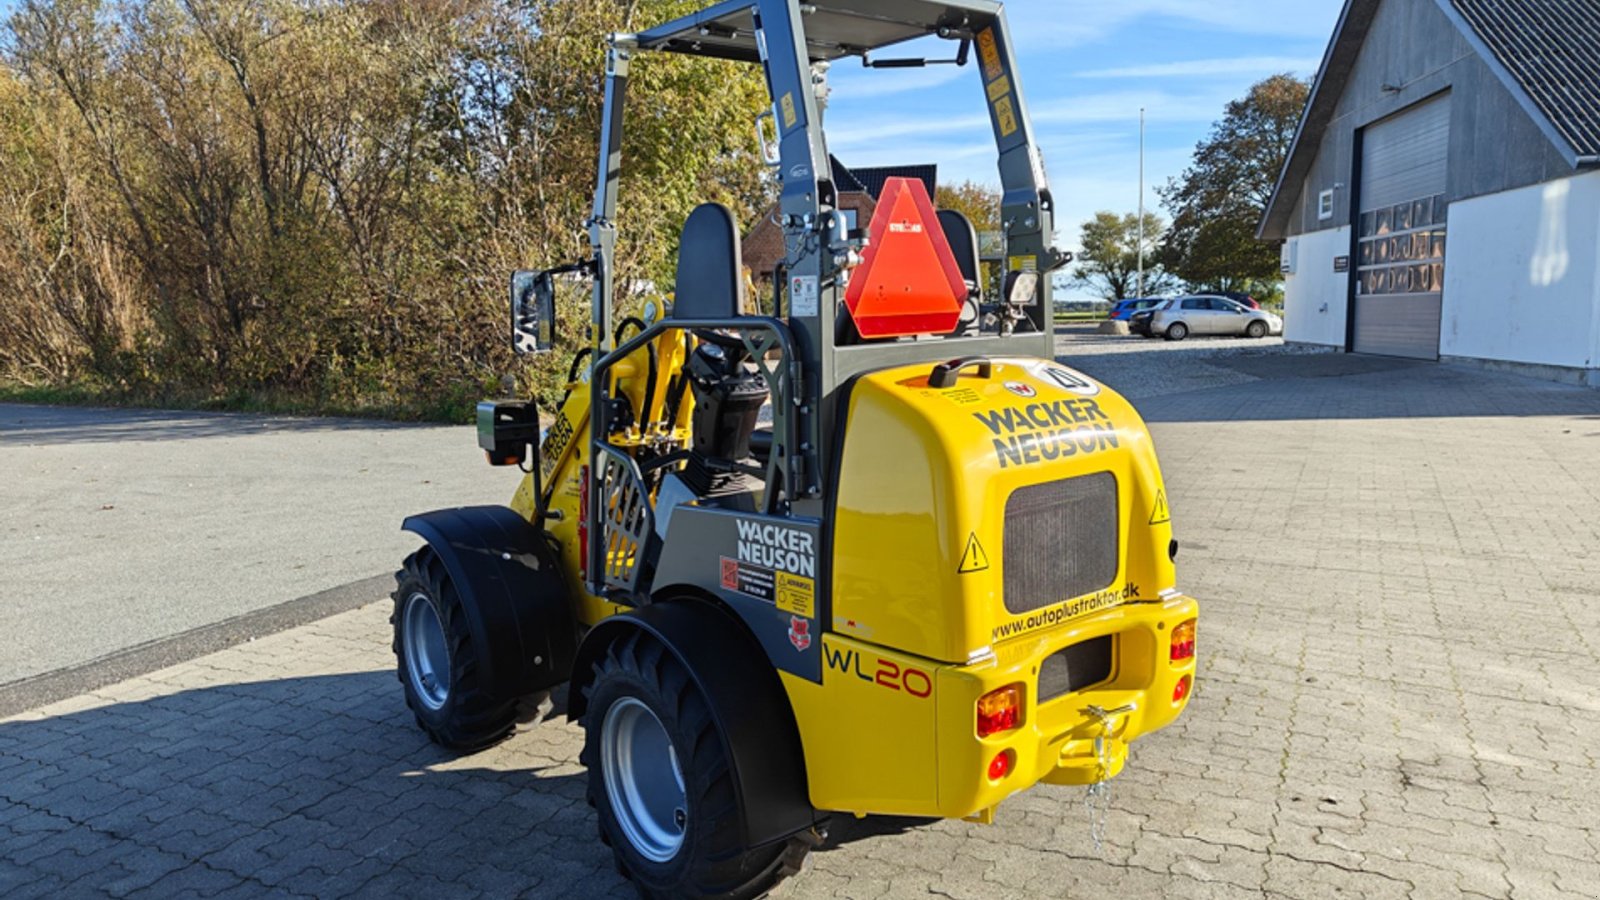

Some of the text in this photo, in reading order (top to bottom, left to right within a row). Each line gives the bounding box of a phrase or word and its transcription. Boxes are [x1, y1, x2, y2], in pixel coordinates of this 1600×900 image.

[972, 398, 1109, 435] WACKER
[993, 422, 1120, 468] NEUSON
[736, 519, 814, 554] WACKER
[738, 539, 815, 578] NEUSON
[823, 642, 933, 699] WL20
